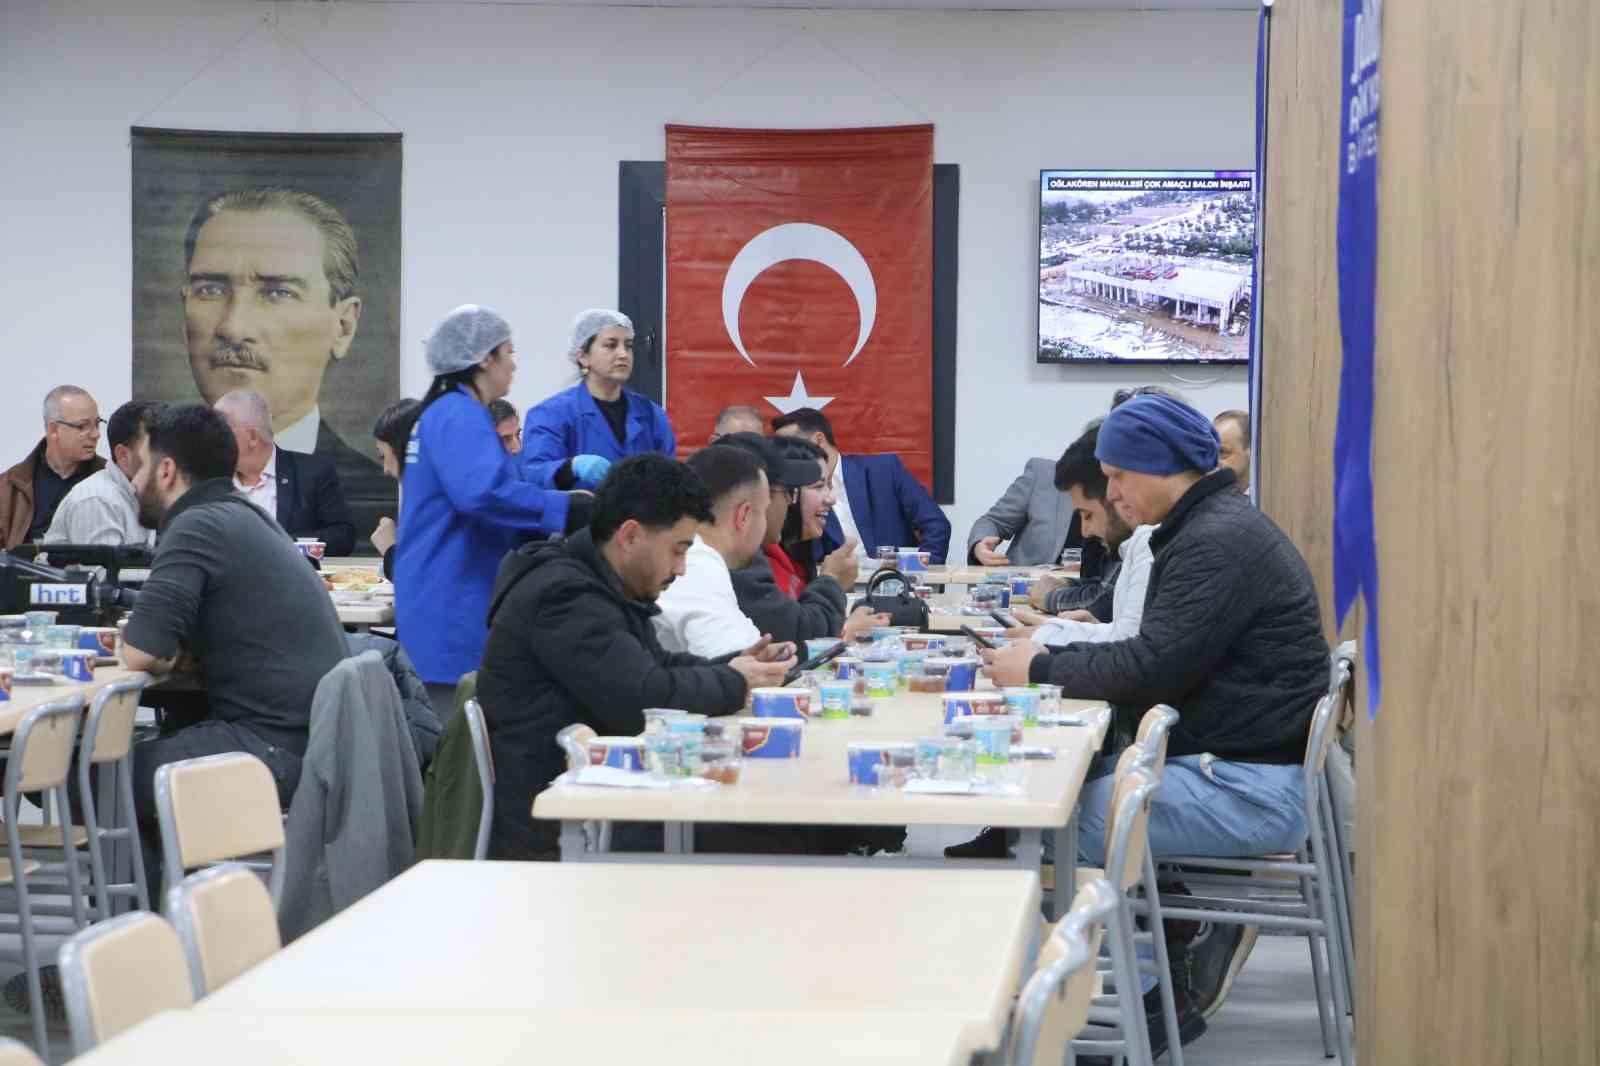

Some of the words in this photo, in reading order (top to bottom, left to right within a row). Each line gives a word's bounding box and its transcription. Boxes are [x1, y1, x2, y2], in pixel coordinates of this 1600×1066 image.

[1100, 179, 1143, 188] MAHALLESİ
[1144, 180, 1161, 189] ÇOK
[1162, 180, 1191, 189] AMAÇLI
[1192, 180, 1219, 188] SALON
[38, 584, 80, 602] hrt
